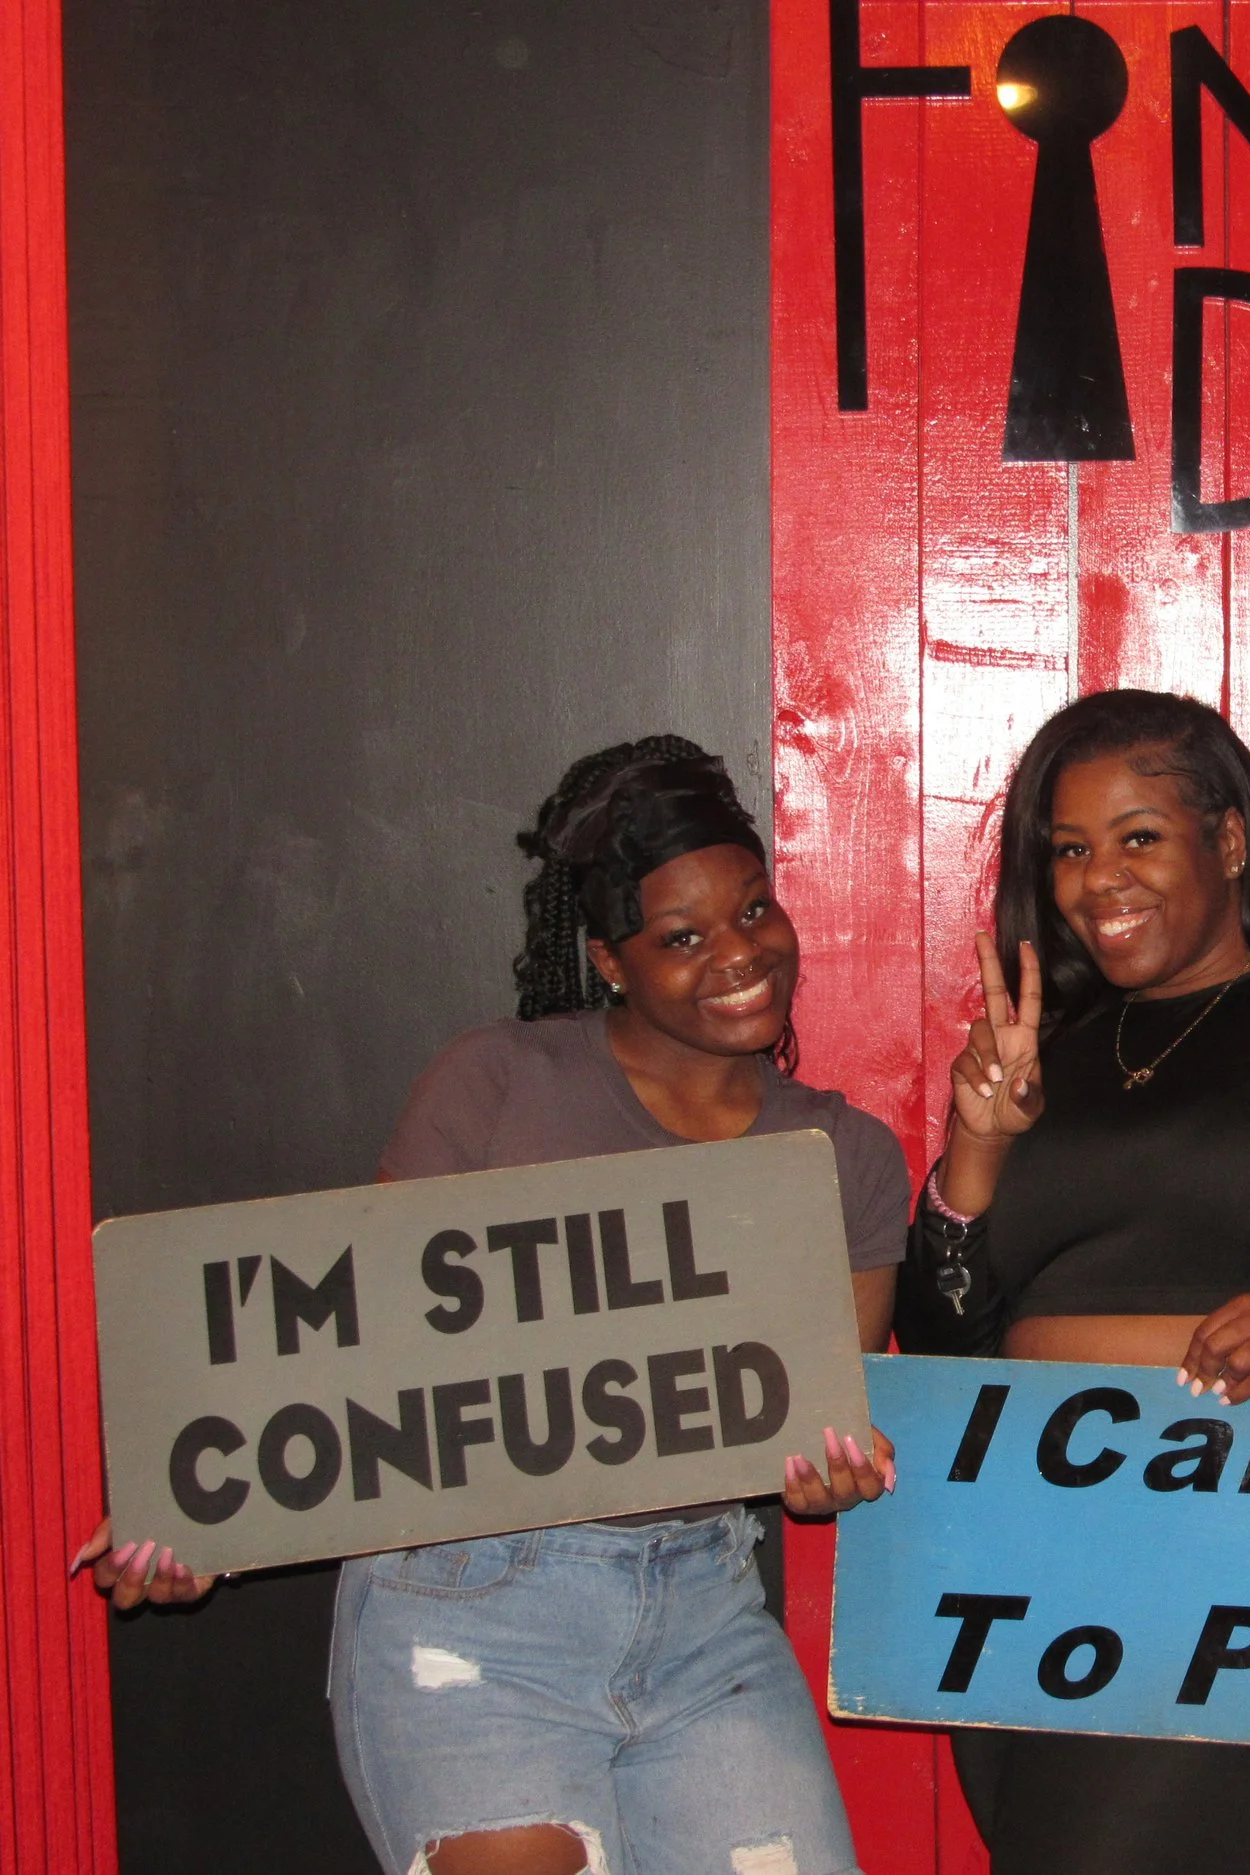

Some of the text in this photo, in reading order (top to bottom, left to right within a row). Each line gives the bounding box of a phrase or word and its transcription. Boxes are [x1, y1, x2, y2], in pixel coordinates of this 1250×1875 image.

[203, 1199, 729, 1366] I'M STILL
[168, 1341, 790, 1525] CONFUSED
[946, 1383, 1011, 1483] I
[934, 1592, 1124, 1701] To
